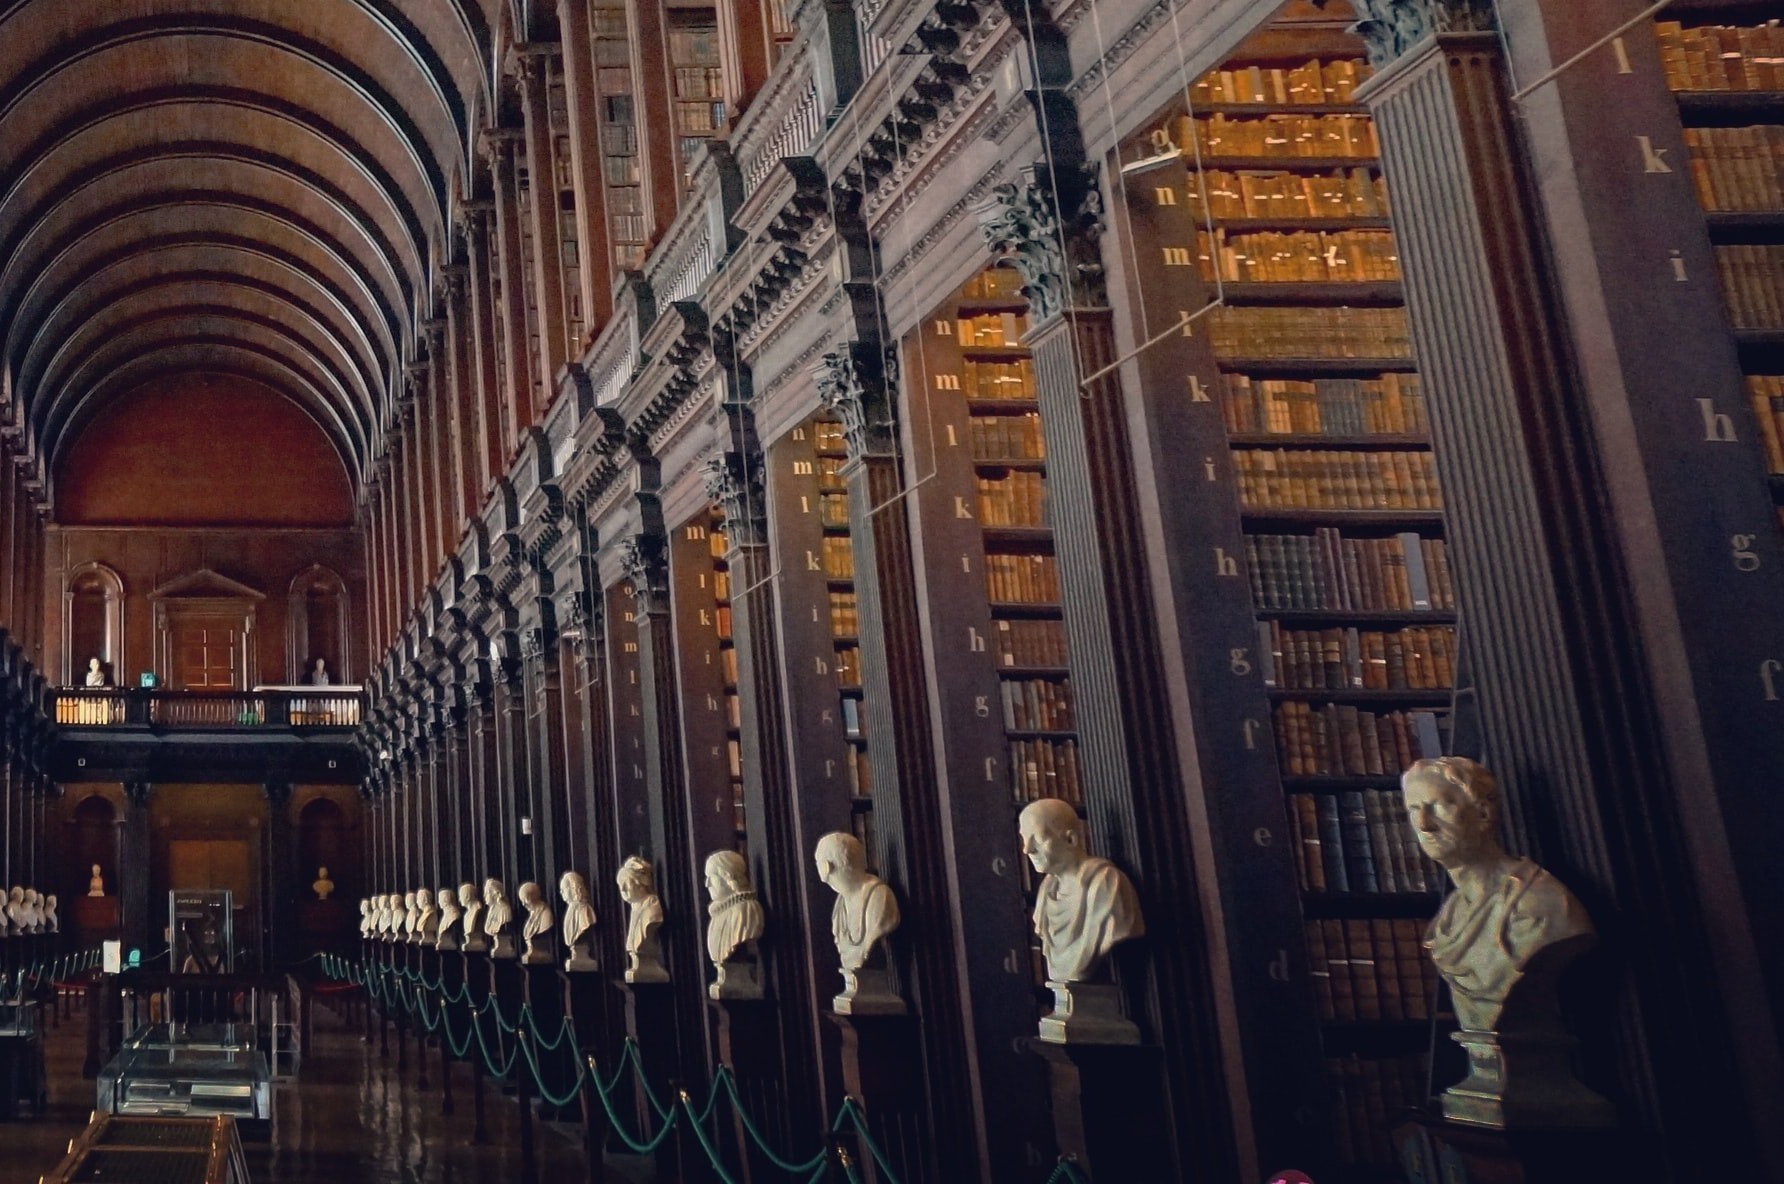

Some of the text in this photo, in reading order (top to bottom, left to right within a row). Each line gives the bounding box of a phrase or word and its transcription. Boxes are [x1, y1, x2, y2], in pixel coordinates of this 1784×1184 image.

[1636, 136, 1672, 173] k
[1156, 188, 1176, 205] n
[1163, 248, 1190, 265] m
[1188, 376, 1210, 402] k
[1695, 398, 1738, 441] h
[1215, 548, 1238, 576] h
[1731, 534, 1759, 571] g
[1231, 648, 1251, 675] g
[1760, 659, 1782, 700] f
[1254, 828, 1271, 846] e
